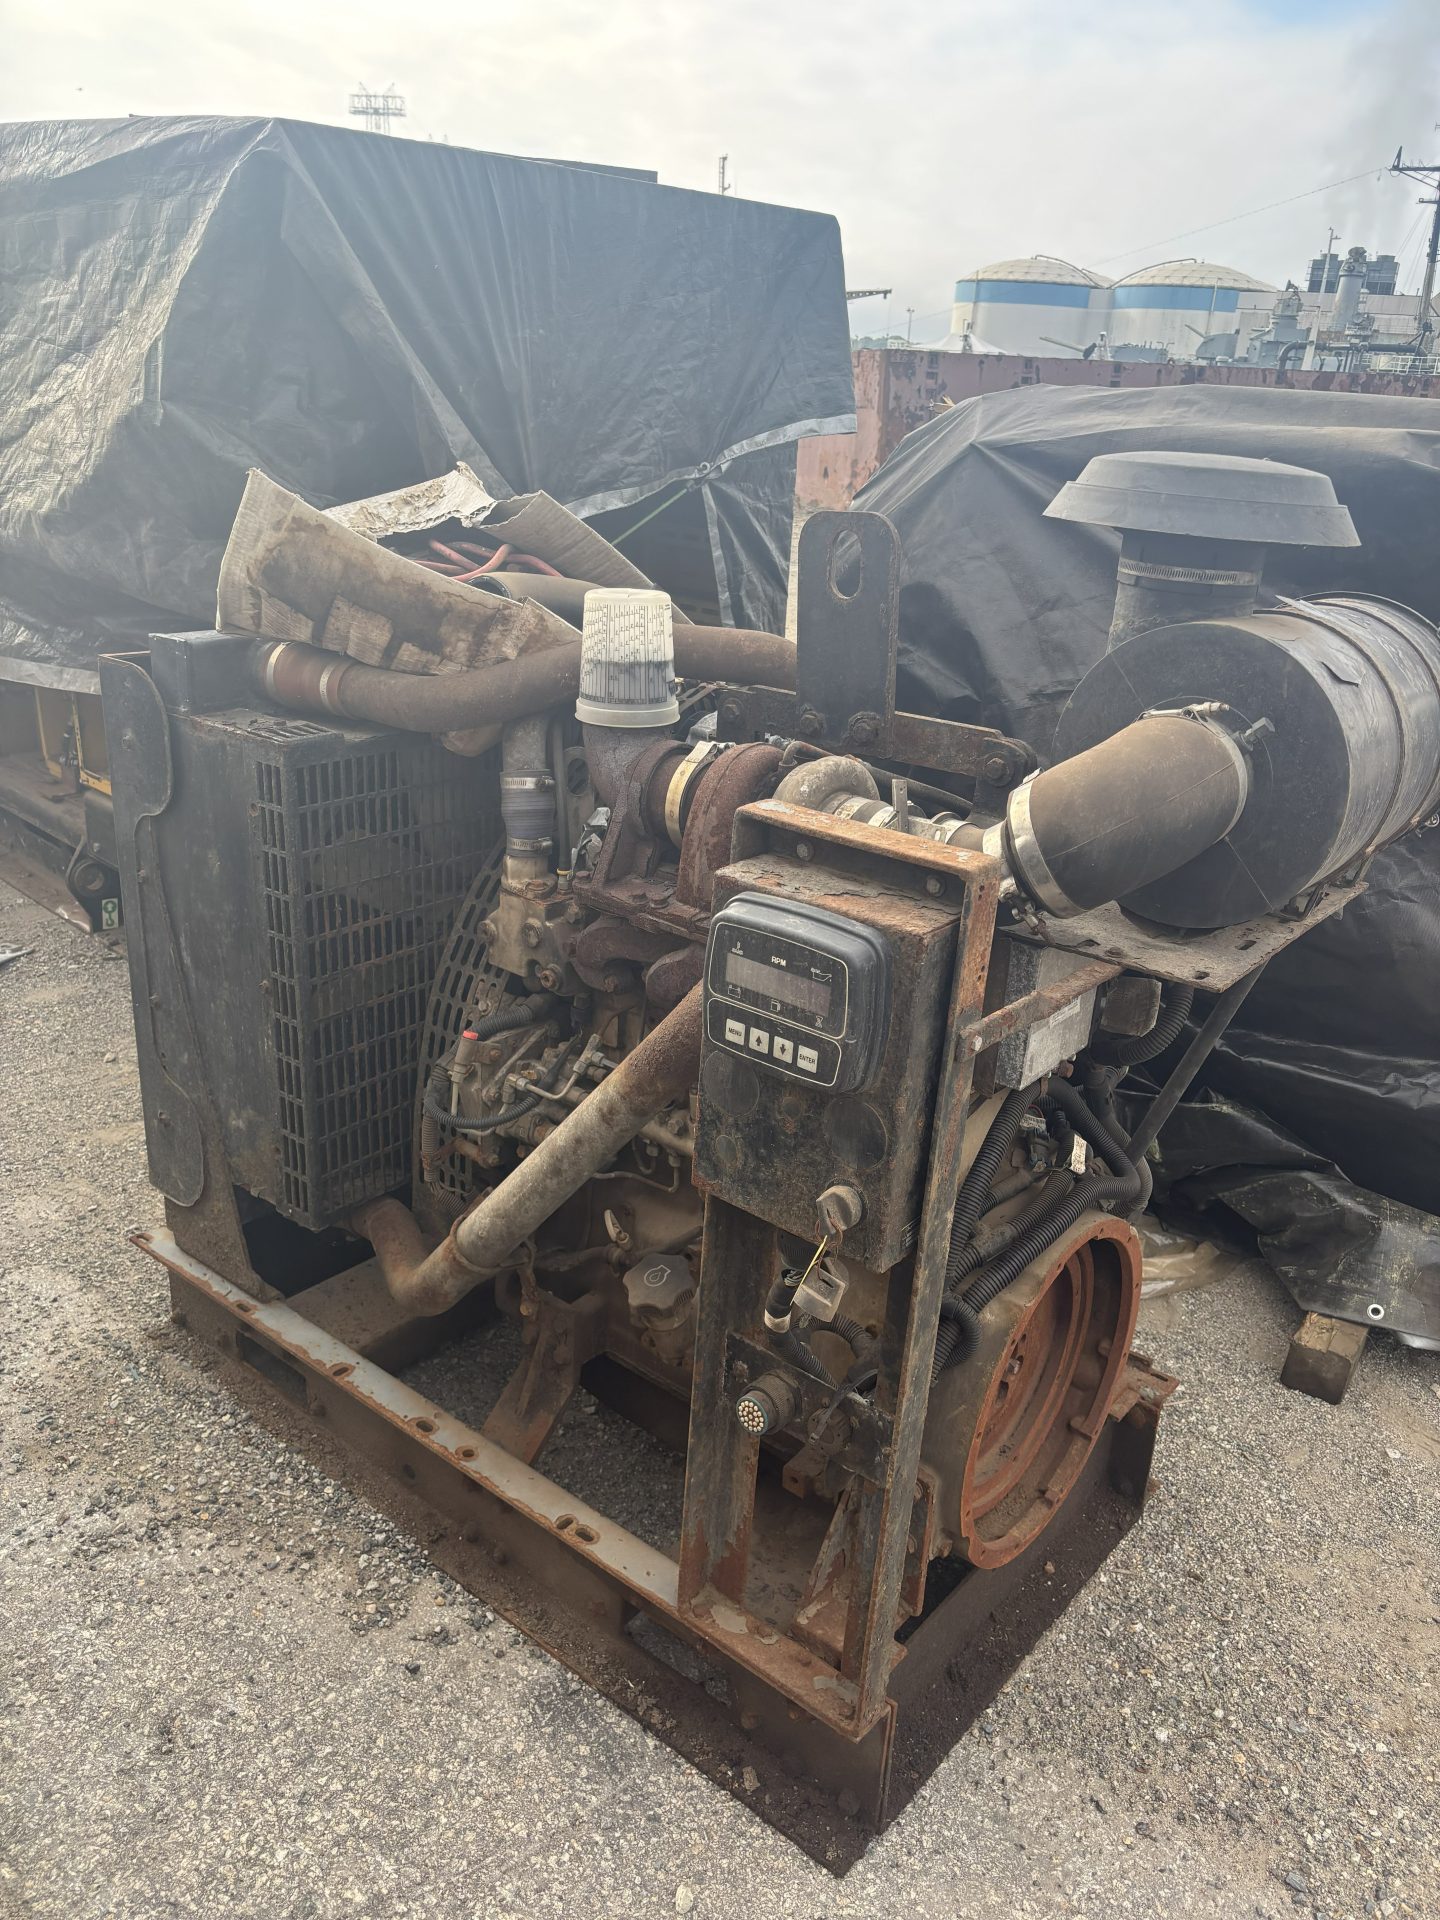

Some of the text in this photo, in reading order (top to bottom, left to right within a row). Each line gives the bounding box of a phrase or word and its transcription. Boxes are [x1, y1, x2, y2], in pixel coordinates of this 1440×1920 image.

[771, 956, 787, 967] RPM
[728, 1027, 742, 1037] MENU
[799, 1053, 816, 1065] ENTER
